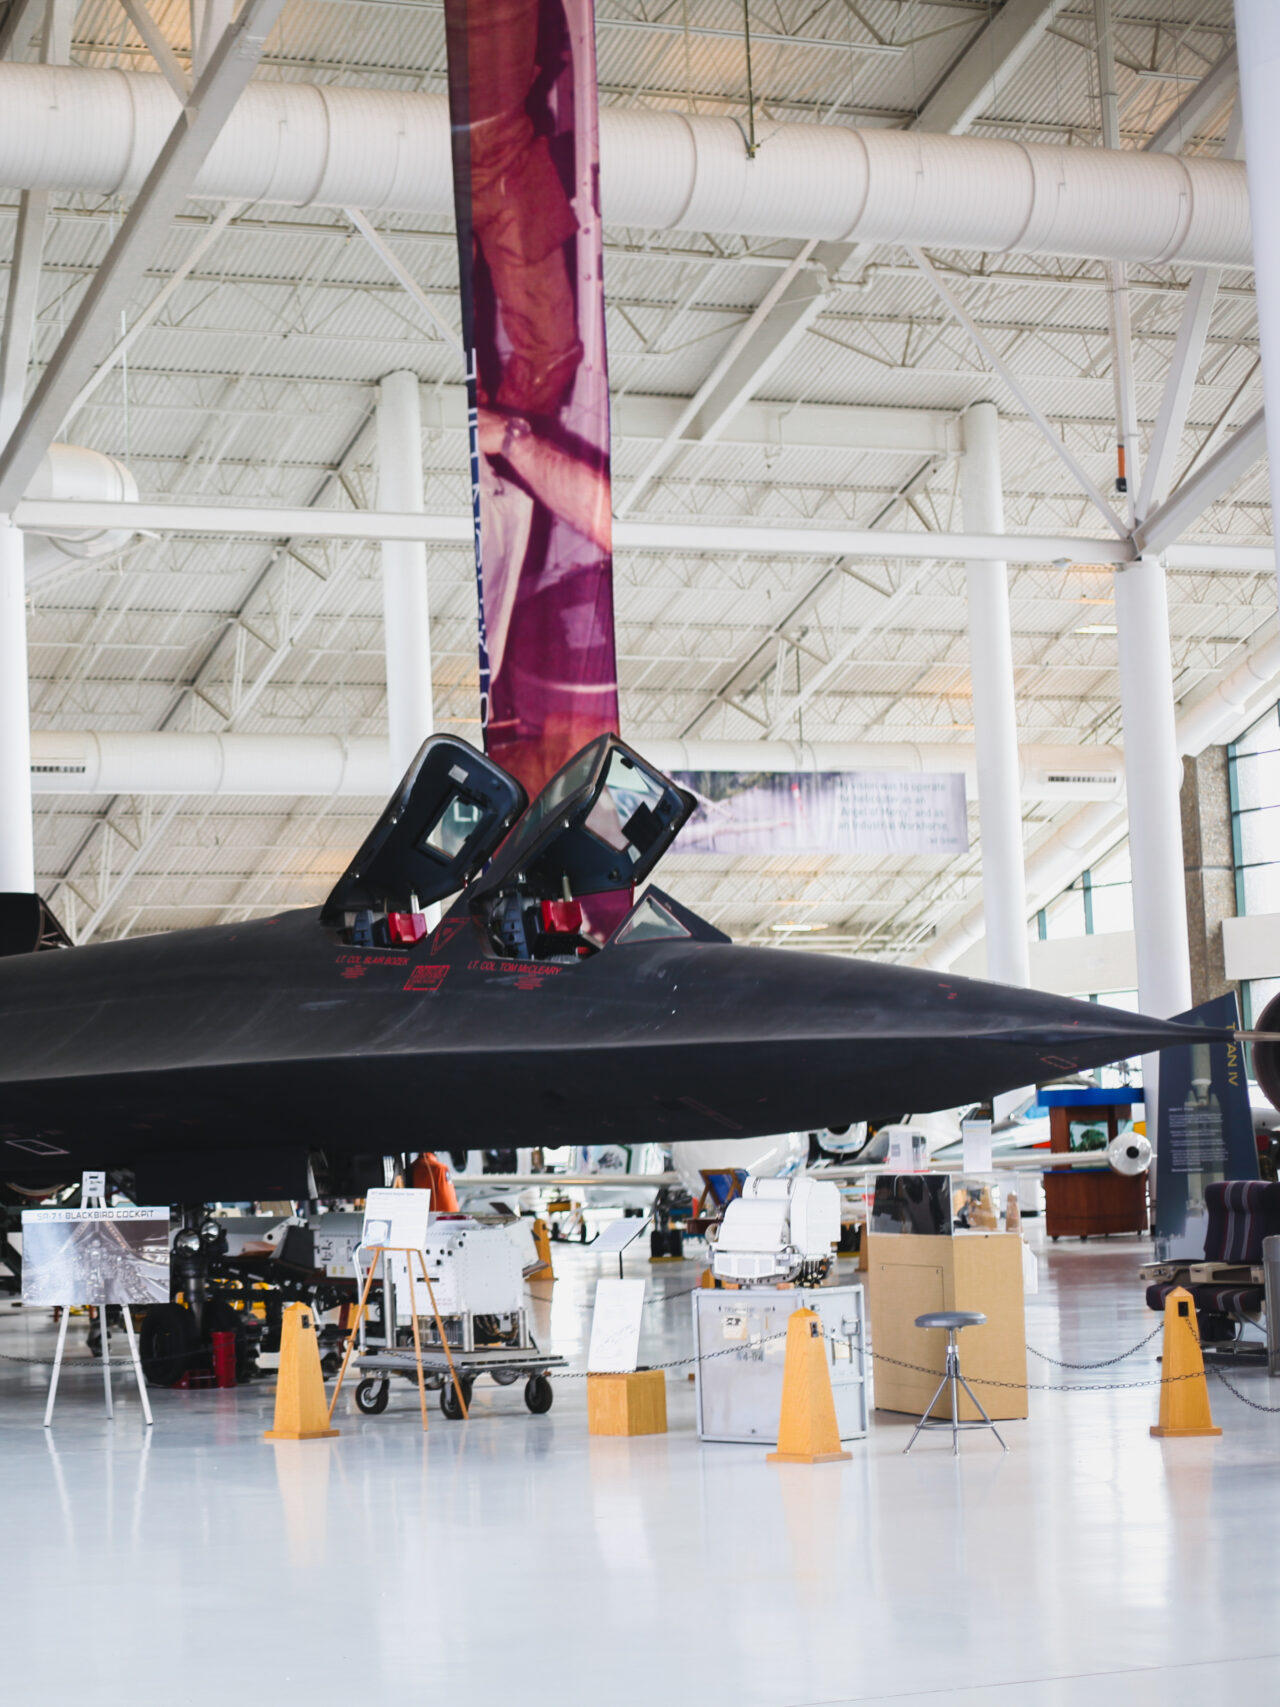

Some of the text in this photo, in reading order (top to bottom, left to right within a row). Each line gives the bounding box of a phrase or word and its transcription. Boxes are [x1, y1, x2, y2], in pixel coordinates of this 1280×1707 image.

[911, 783, 946, 792] operate
[500, 962, 518, 972] TOM
[1225, 1021, 1237, 1067] TAN
[36, 1209, 154, 1221] SR-71 BLACKBIRD COCKPIT
